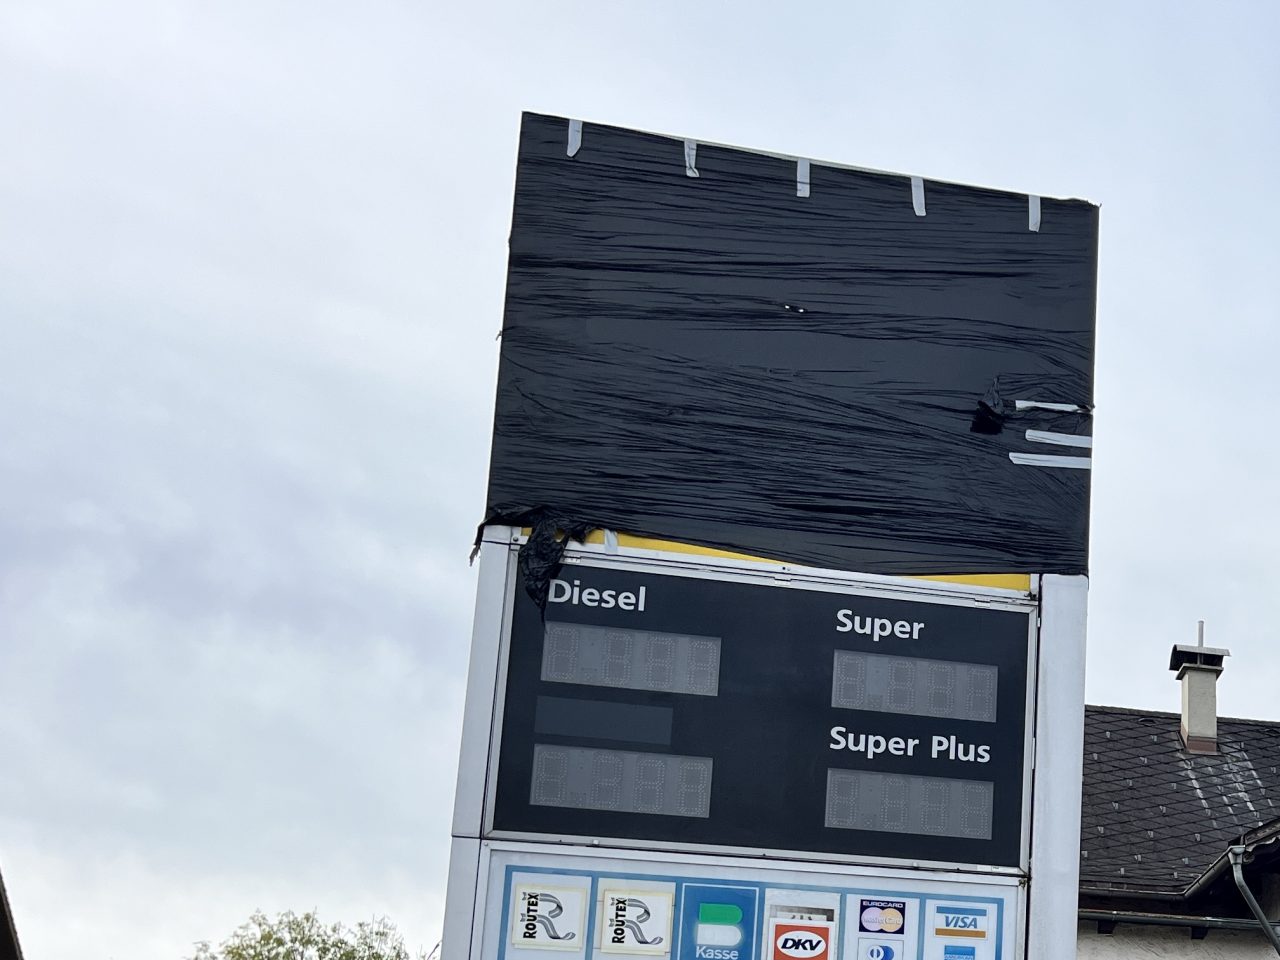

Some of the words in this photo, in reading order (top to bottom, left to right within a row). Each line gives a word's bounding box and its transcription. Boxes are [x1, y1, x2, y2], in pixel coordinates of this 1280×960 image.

[548, 579, 646, 612] Diesel
[836, 609, 925, 642] Super
[829, 726, 920, 760] Super
[931, 735, 991, 763] Plus
[523, 892, 540, 939] ROUTEX
[862, 900, 904, 908] EUROCARD
[612, 898, 627, 944] ROUTEX
[944, 915, 978, 929] VISA
[695, 946, 739, 960] Kasse
[781, 938, 822, 951] DKV
